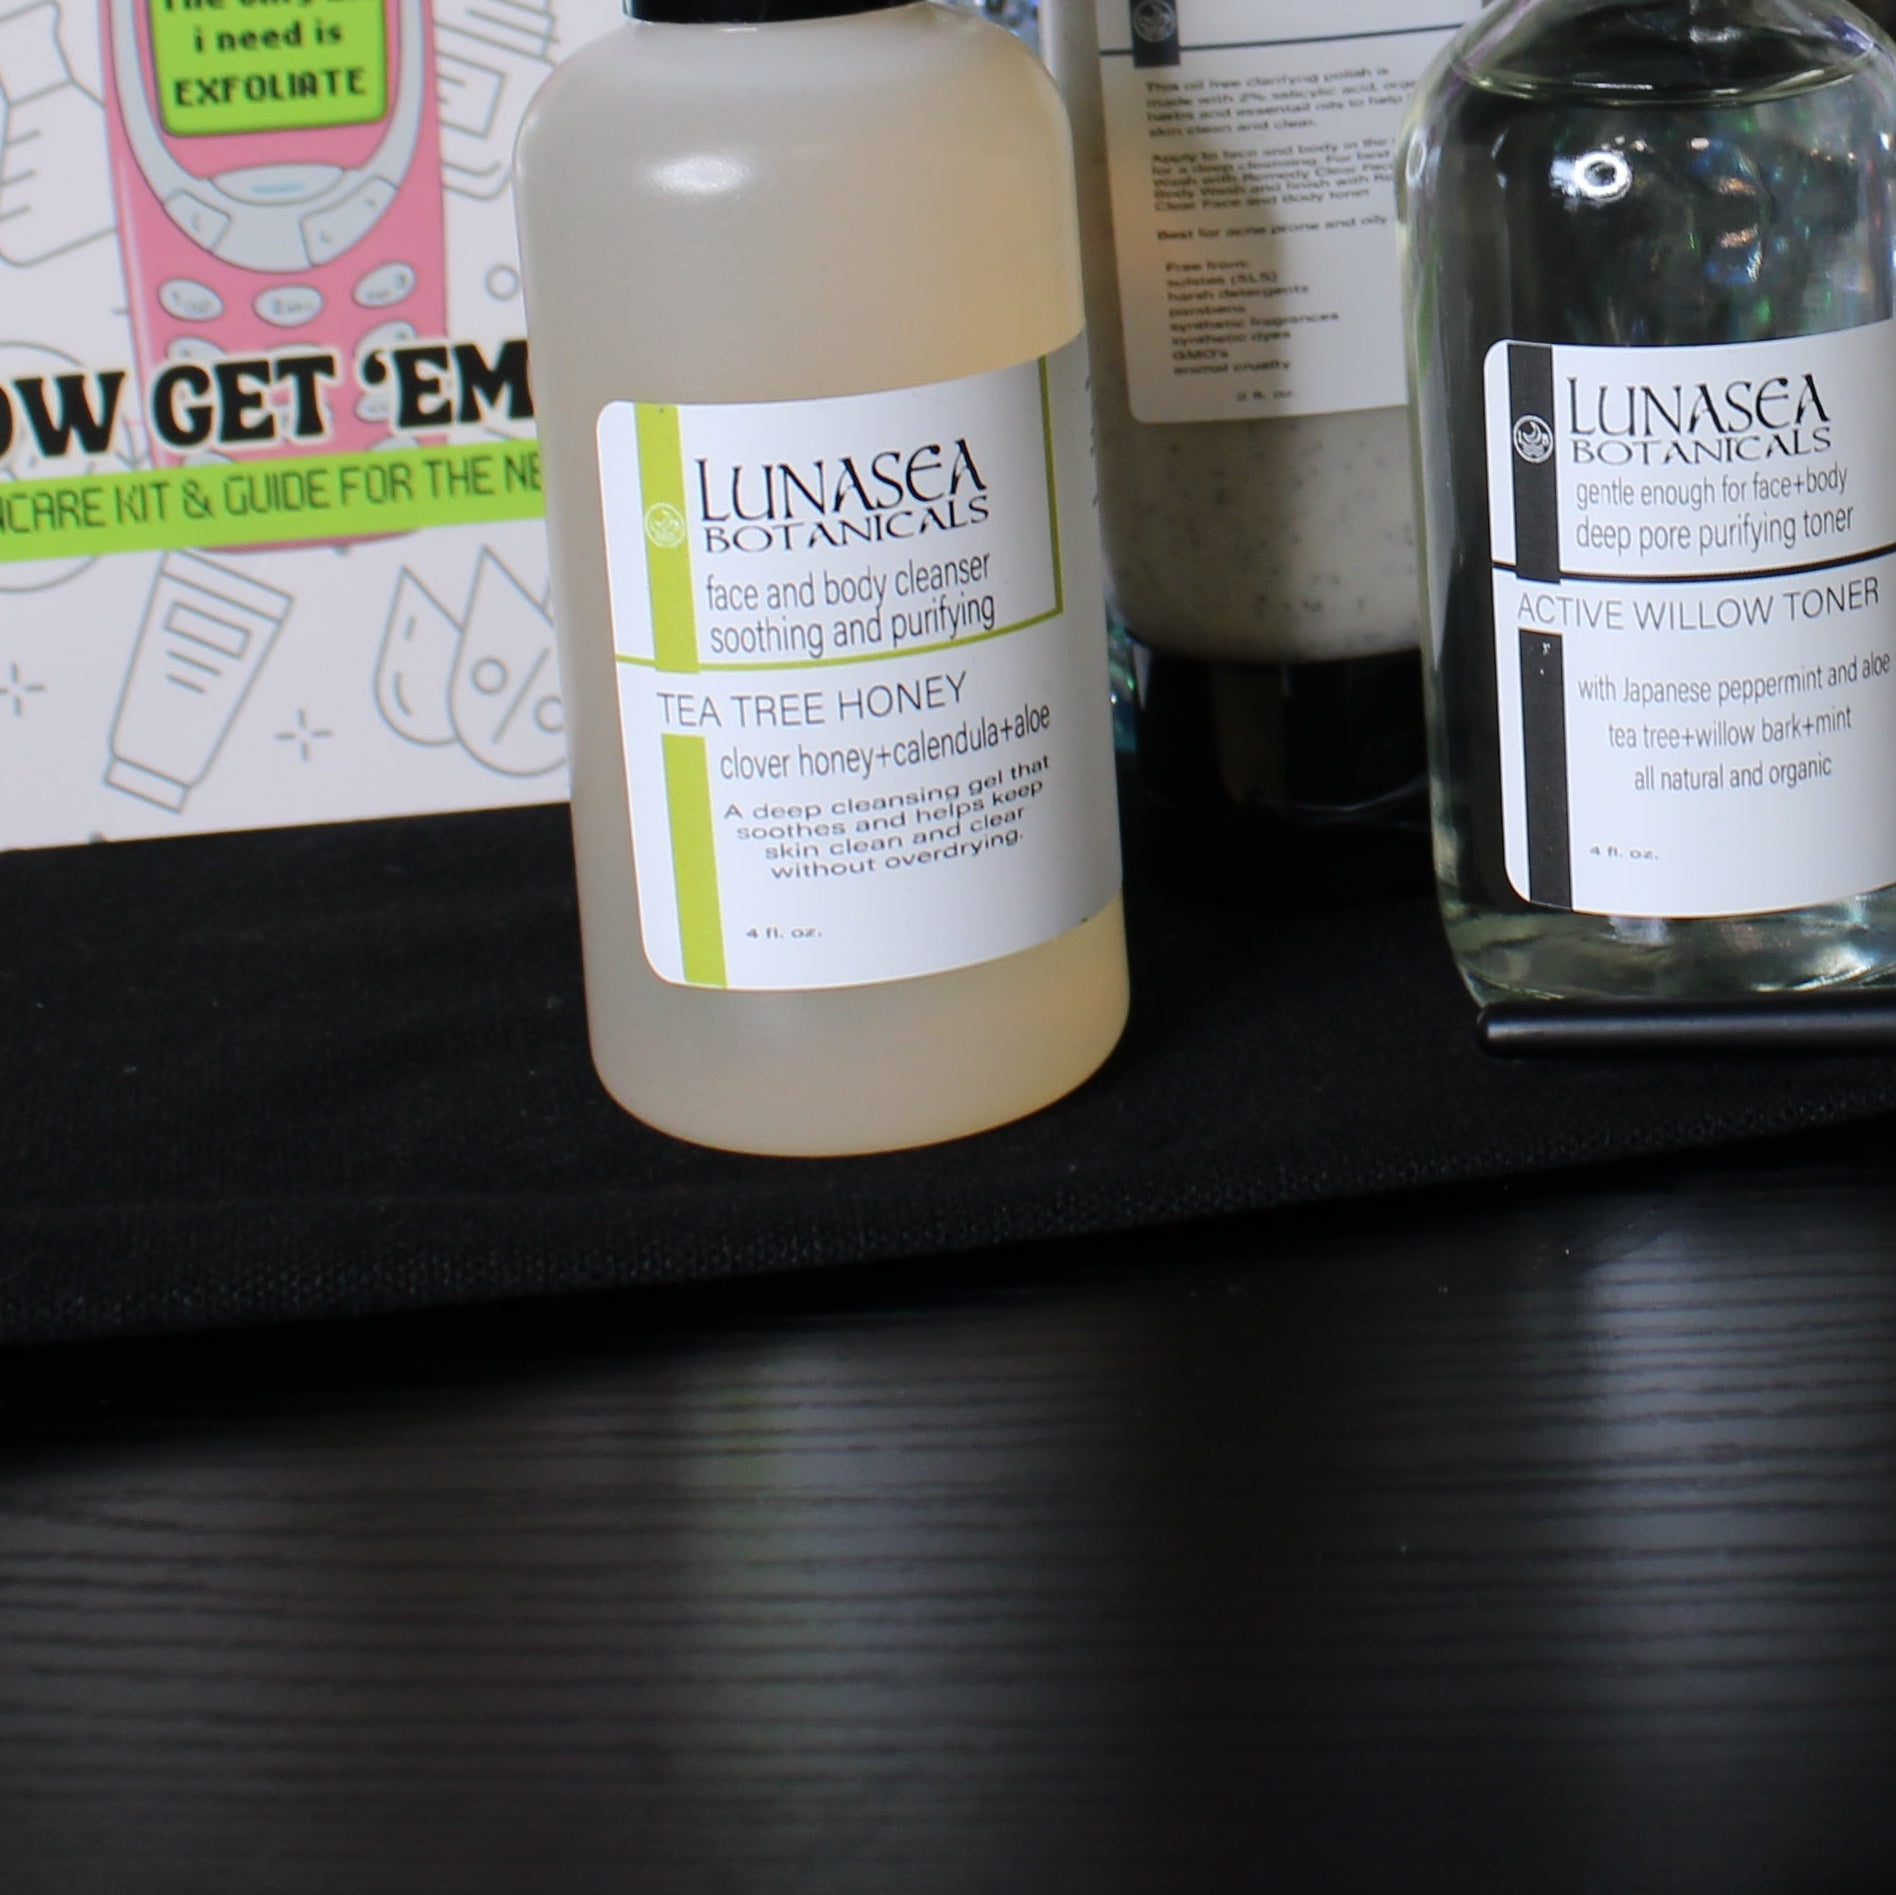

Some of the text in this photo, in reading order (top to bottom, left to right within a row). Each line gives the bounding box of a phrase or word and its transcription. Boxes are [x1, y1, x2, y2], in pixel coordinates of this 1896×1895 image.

[193, 18, 343, 53] i need is
[173, 67, 366, 108] EXFOLIATE
[153, 354, 336, 446] GET
[1566, 373, 1832, 438] LUNASEA
[1571, 426, 1832, 466] BOTANICALS
[114, 481, 170, 525] KIT
[181, 478, 214, 521] &
[223, 466, 332, 516] GUIDE
[338, 462, 412, 506] FOR
[423, 455, 495, 499] THE
[693, 437, 988, 523] LUNASEA
[1575, 461, 1849, 512] gentle enough for face+body
[704, 494, 990, 554] BOTANICALS
[1575, 505, 1855, 558] deep pore purifying toner
[706, 552, 991, 615] face and body cleanser
[1516, 576, 1880, 632] ACTIVE WILLOW TONER
[710, 590, 996, 659] soothing and purifying
[656, 670, 969, 728] TEA TREE HONEY
[1577, 651, 1891, 708] with Japanese peppermint and aloe
[719, 702, 1051, 780] clover honey+calendula+aloe
[1608, 704, 1853, 750] tea tree+willow bark+mint
[723, 755, 1050, 823] A deep cleansing gel that
[1634, 750, 1833, 792] all natural and organic
[736, 779, 1044, 841] soothes and helps keep
[764, 806, 1026, 860] skin clean and clear
[770, 828, 1024, 880] without overdrying.
[745, 927, 758, 939] 4
